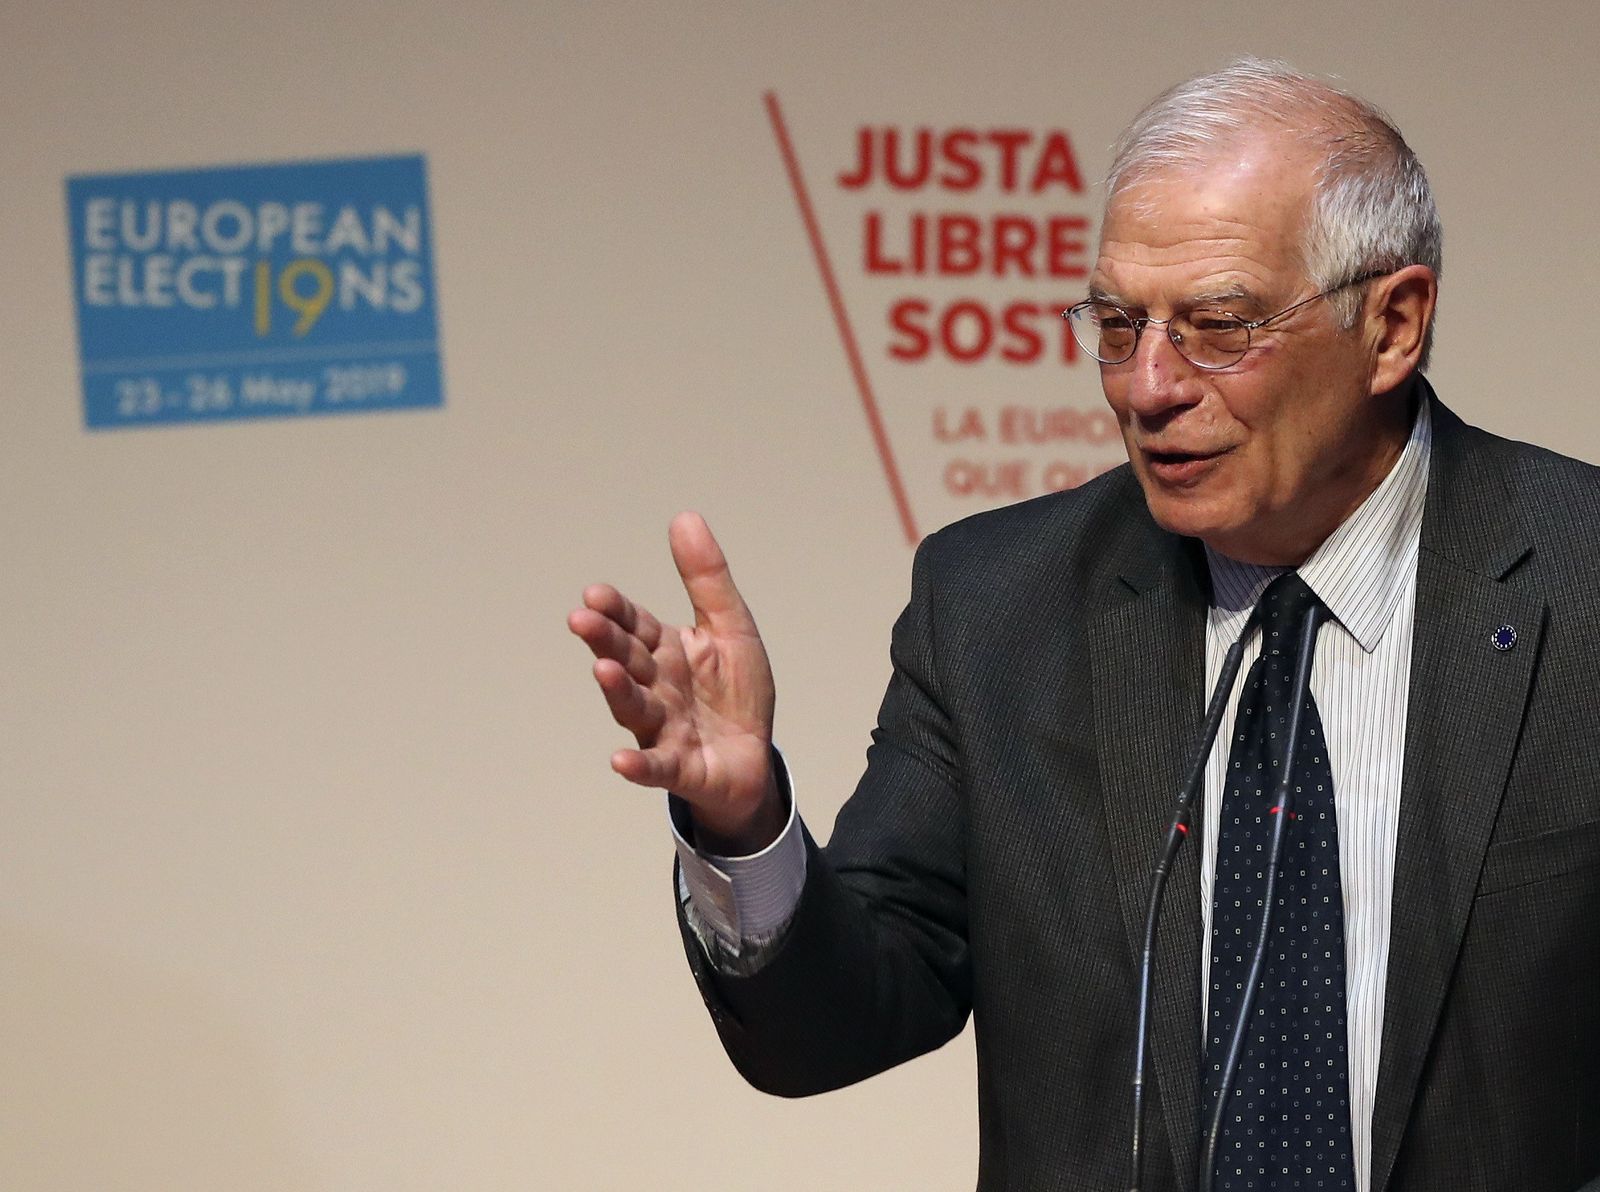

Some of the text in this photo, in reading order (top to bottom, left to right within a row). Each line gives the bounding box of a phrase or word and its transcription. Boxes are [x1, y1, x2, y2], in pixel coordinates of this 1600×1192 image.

[837, 127, 1084, 193] JUSTA
[86, 199, 421, 254] EUROPEAN
[864, 210, 1090, 280] LIBRE
[241, 375, 316, 413] May
[931, 405, 987, 443] LA
[943, 459, 1031, 496] QUE
